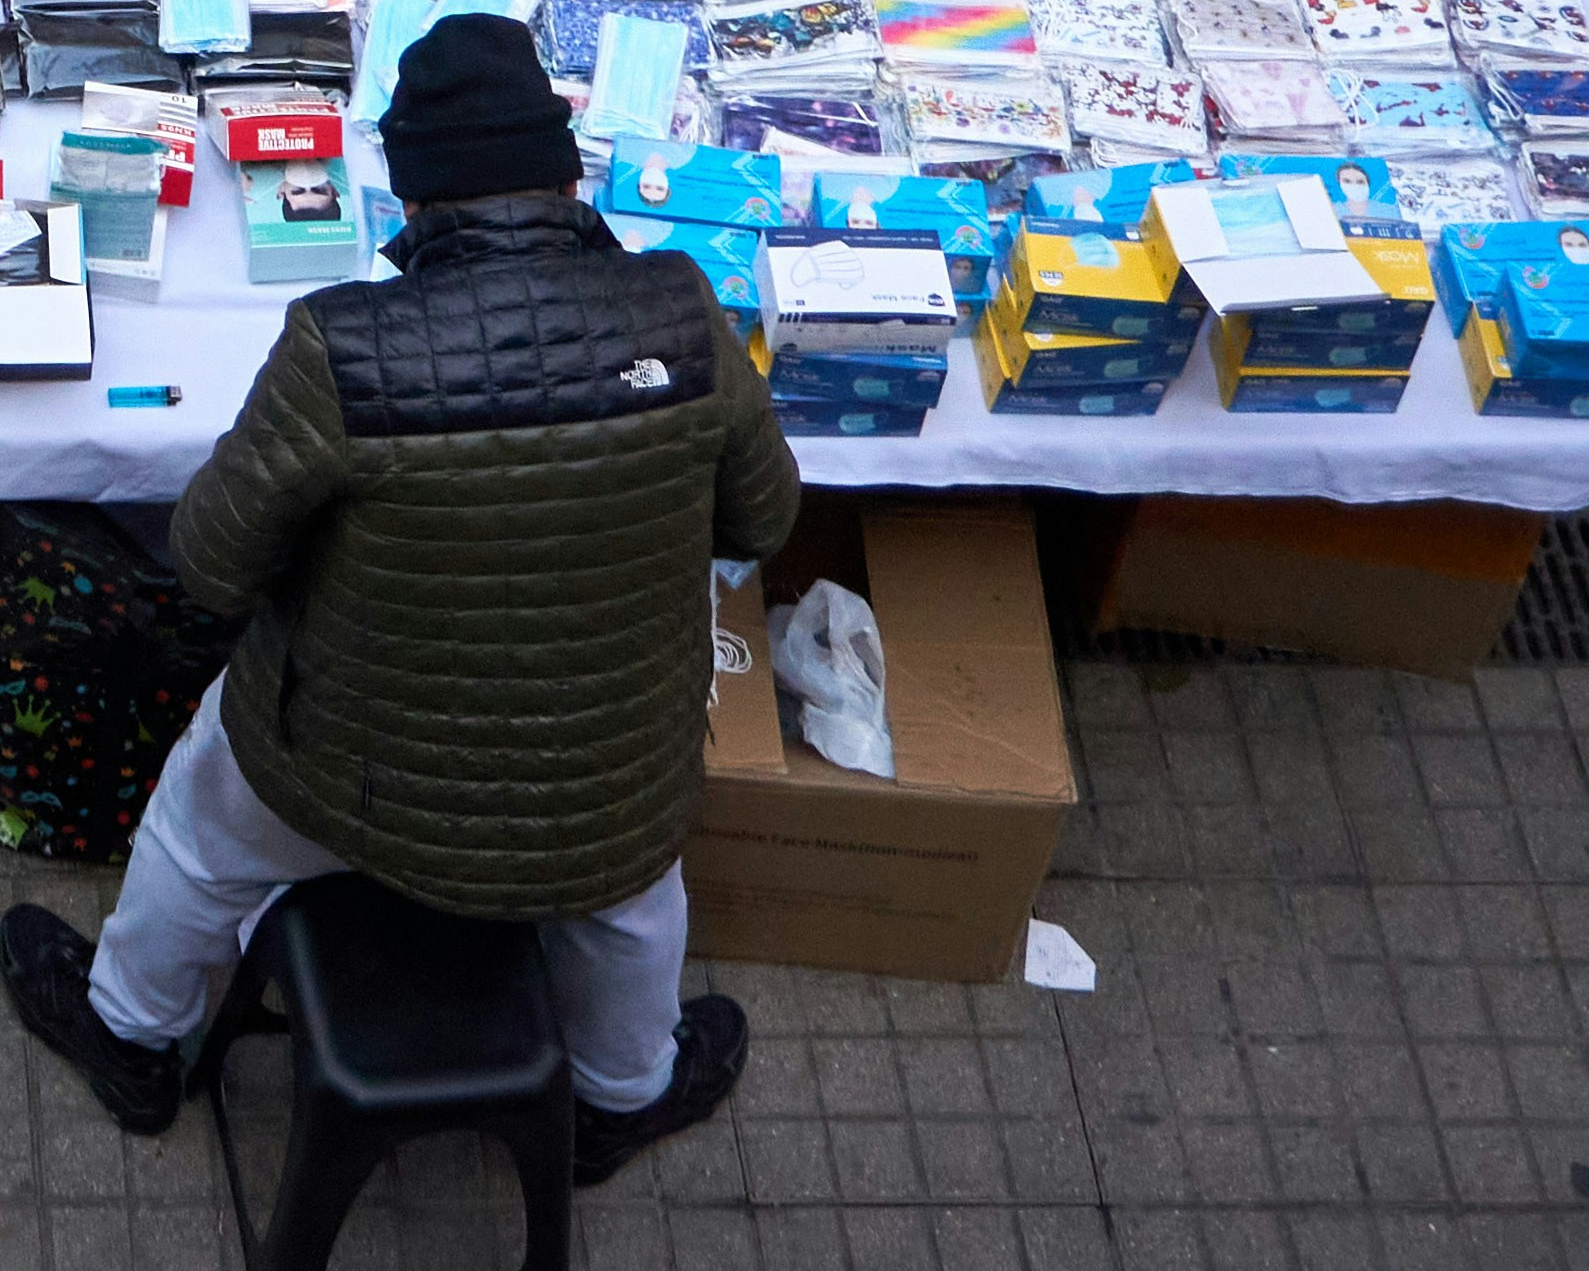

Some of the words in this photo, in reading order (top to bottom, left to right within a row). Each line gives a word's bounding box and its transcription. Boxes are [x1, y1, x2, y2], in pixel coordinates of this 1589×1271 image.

[161, 124, 193, 136] KN95
[257, 128, 286, 140] MASK
[257, 137, 315, 151] PROTECTIVE
[619, 369, 652, 382] NORTH
